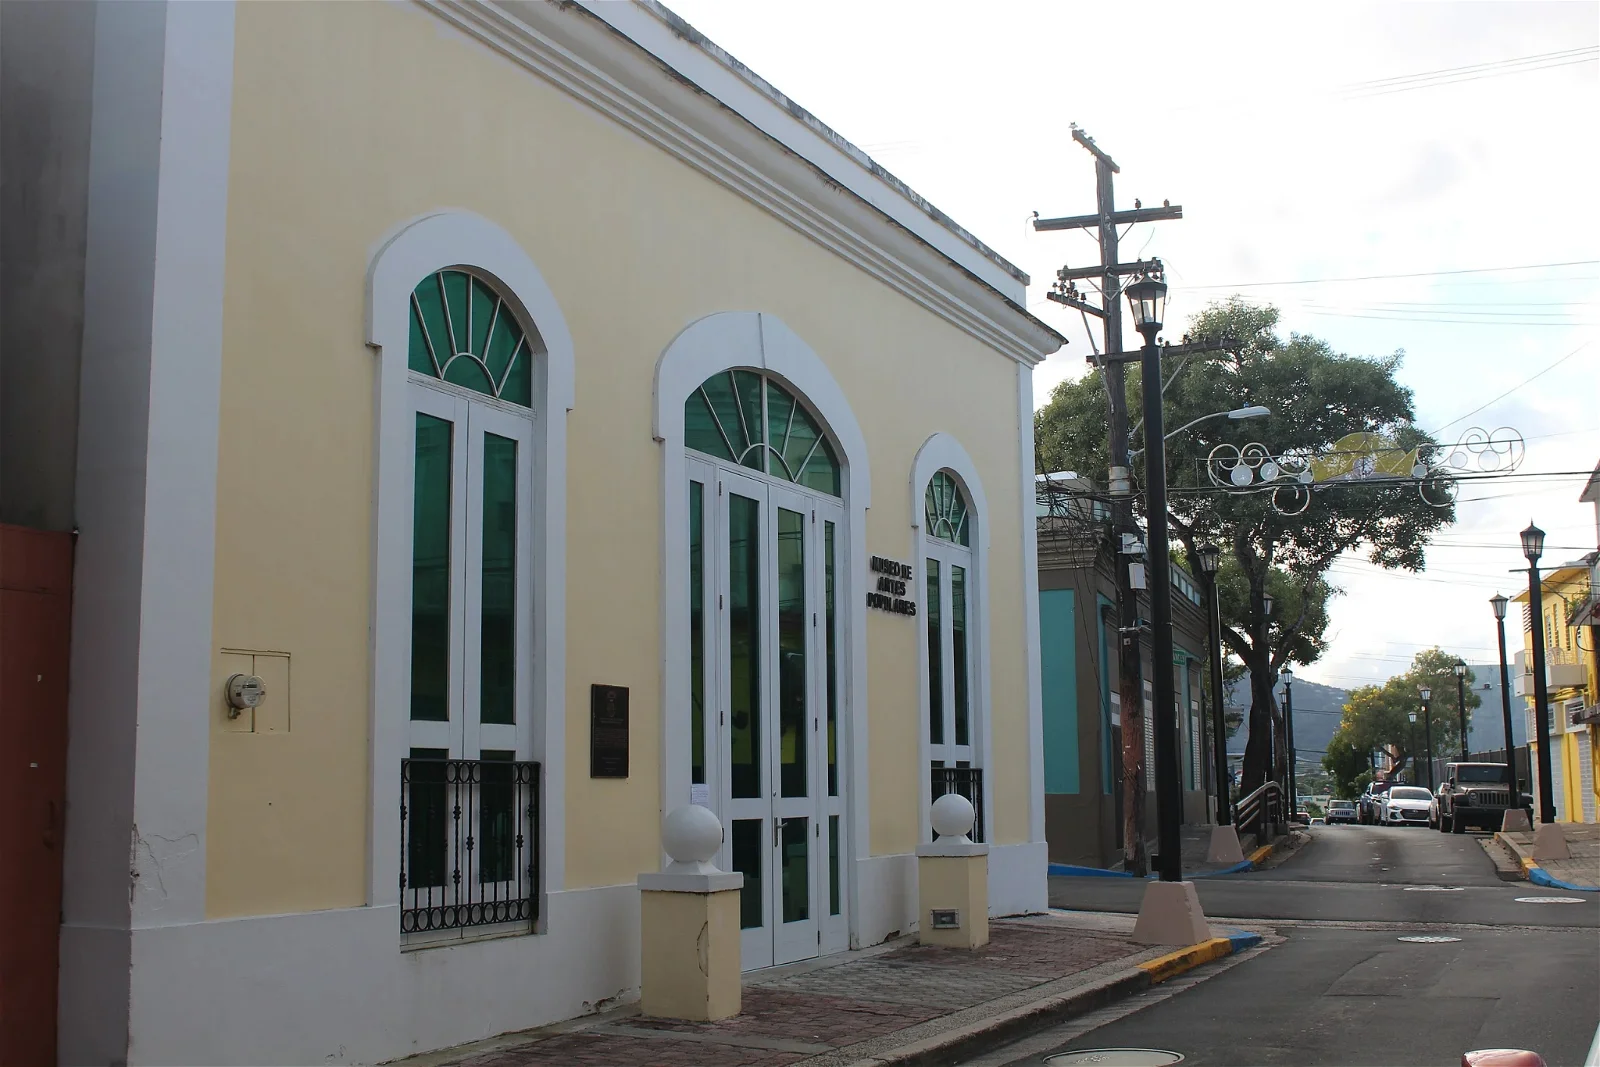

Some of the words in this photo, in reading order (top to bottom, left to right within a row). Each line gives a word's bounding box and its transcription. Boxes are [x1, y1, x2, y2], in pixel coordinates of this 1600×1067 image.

[871, 556, 900, 576] MUSEO
[901, 564, 912, 580] DE
[878, 577, 906, 596] ARTES
[867, 592, 916, 616] POPULARES
